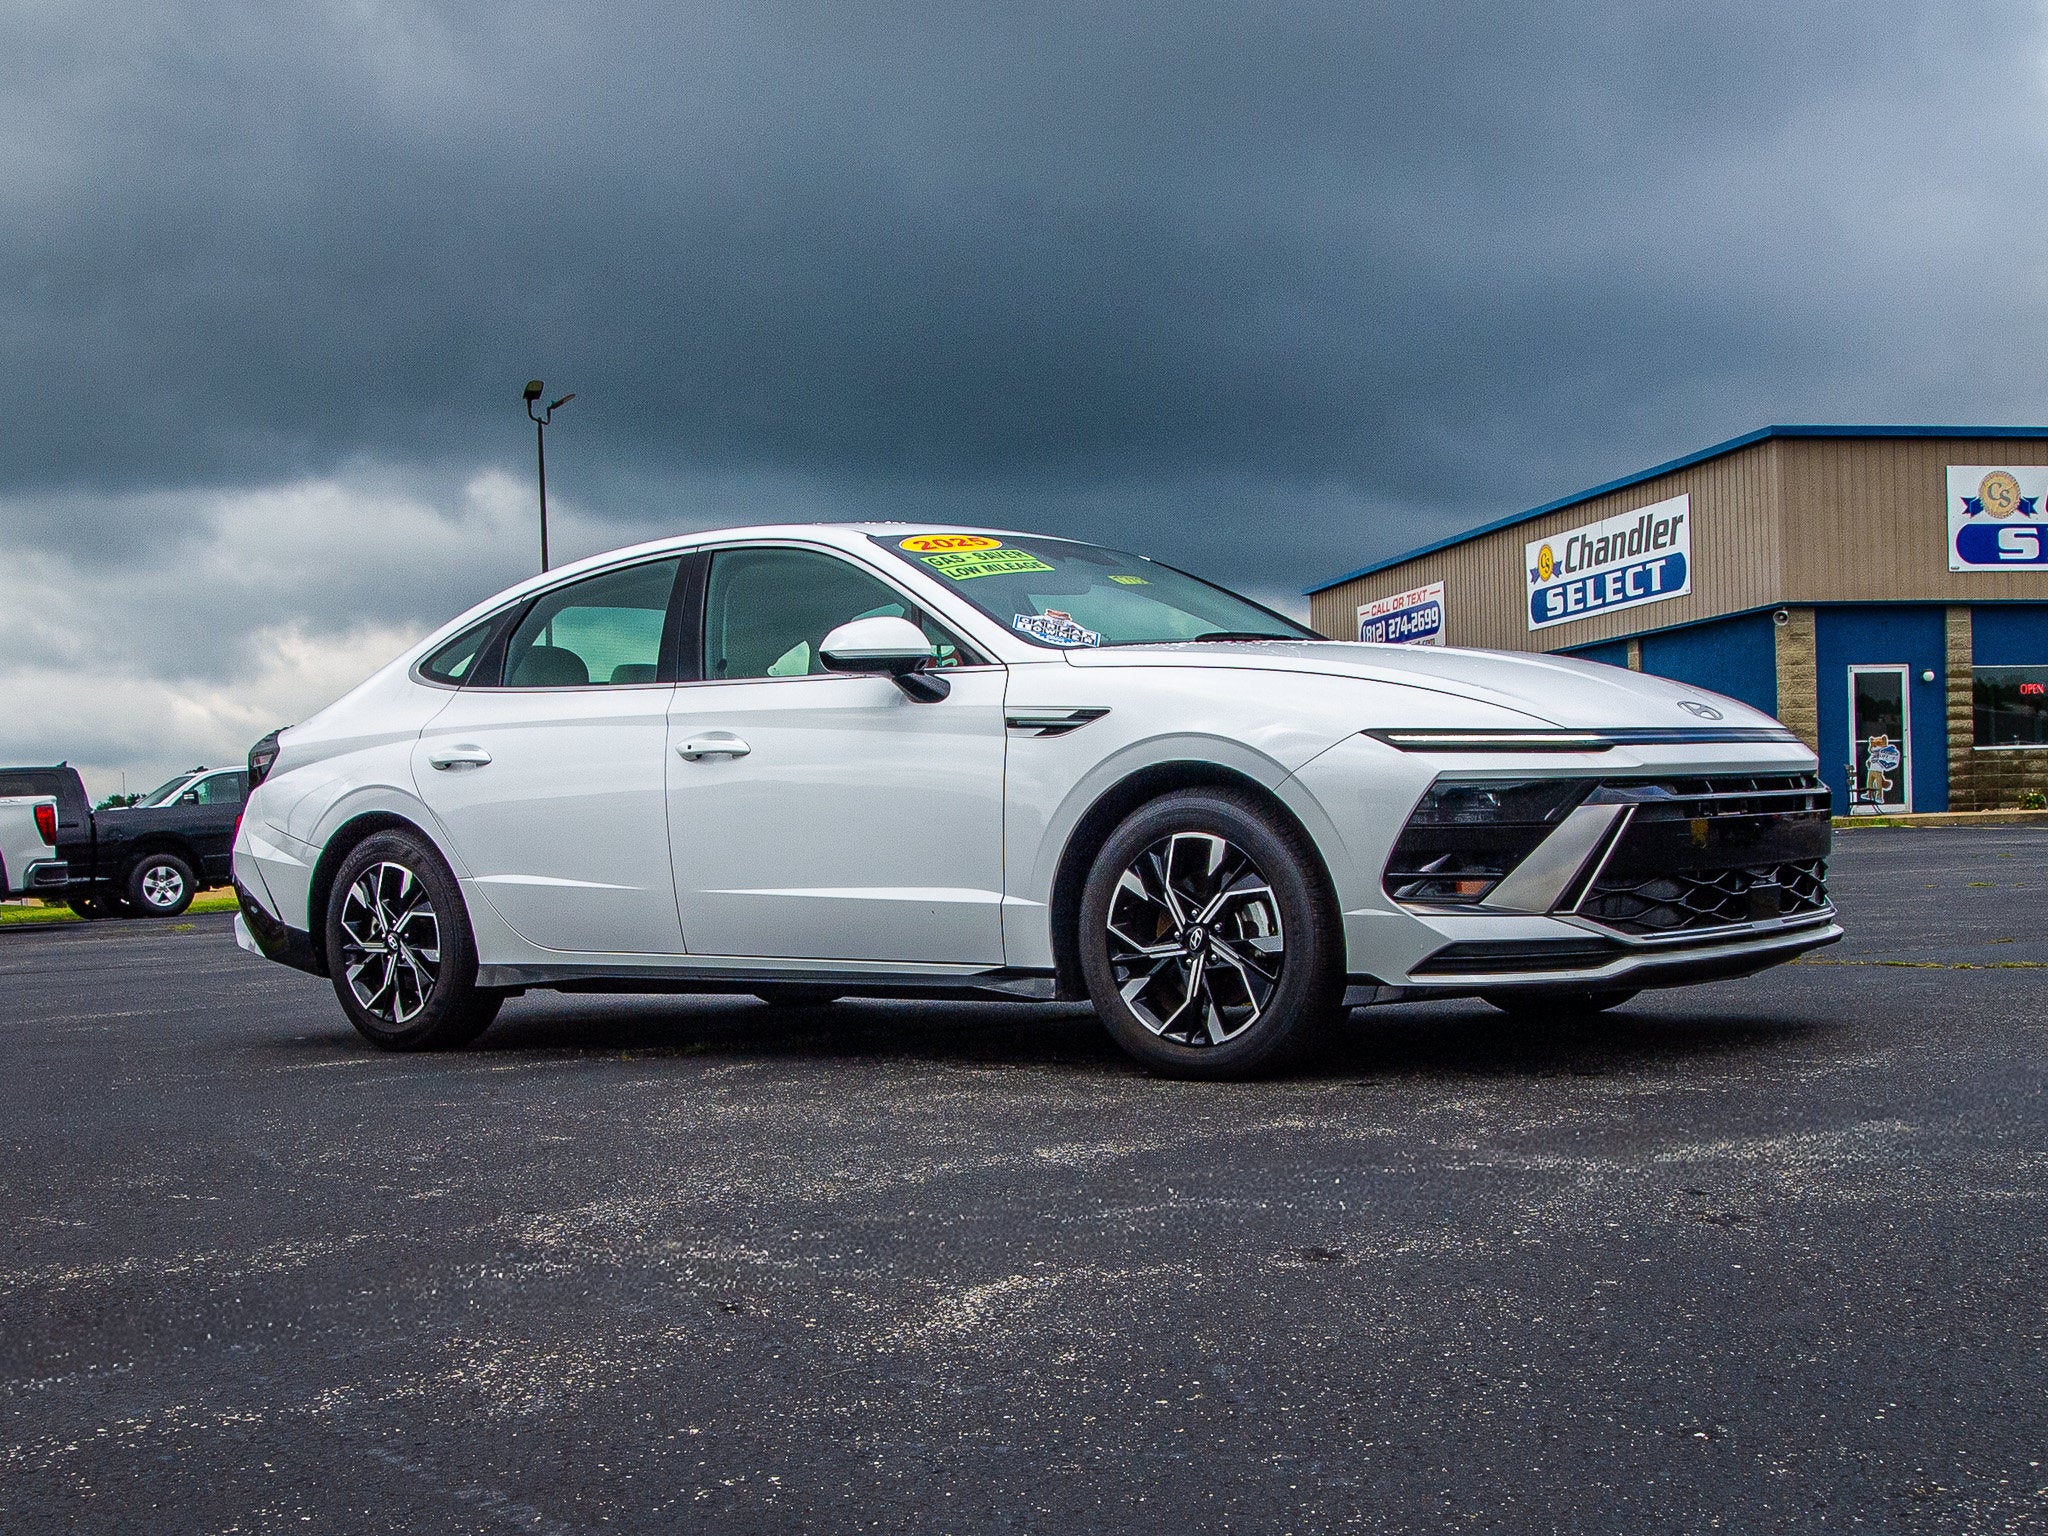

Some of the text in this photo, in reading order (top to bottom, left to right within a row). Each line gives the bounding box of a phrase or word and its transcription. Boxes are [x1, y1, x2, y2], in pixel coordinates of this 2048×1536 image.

[1988, 482, 2011, 508] CS
[914, 537, 989, 551] 2025
[1564, 513, 1684, 574] Chandler
[1998, 527, 2048, 560] S
[928, 554, 966, 567] GAS
[972, 550, 1030, 561] SAVER
[946, 561, 1046, 578] LOW MILEAGE
[1540, 553, 1551, 574] CS
[1546, 559, 1666, 617] SELECT
[1371, 590, 1427, 616] CALL OR TEXT
[1362, 606, 1439, 643] (812) 274-2699
[2020, 683, 2045, 695] OPEN
